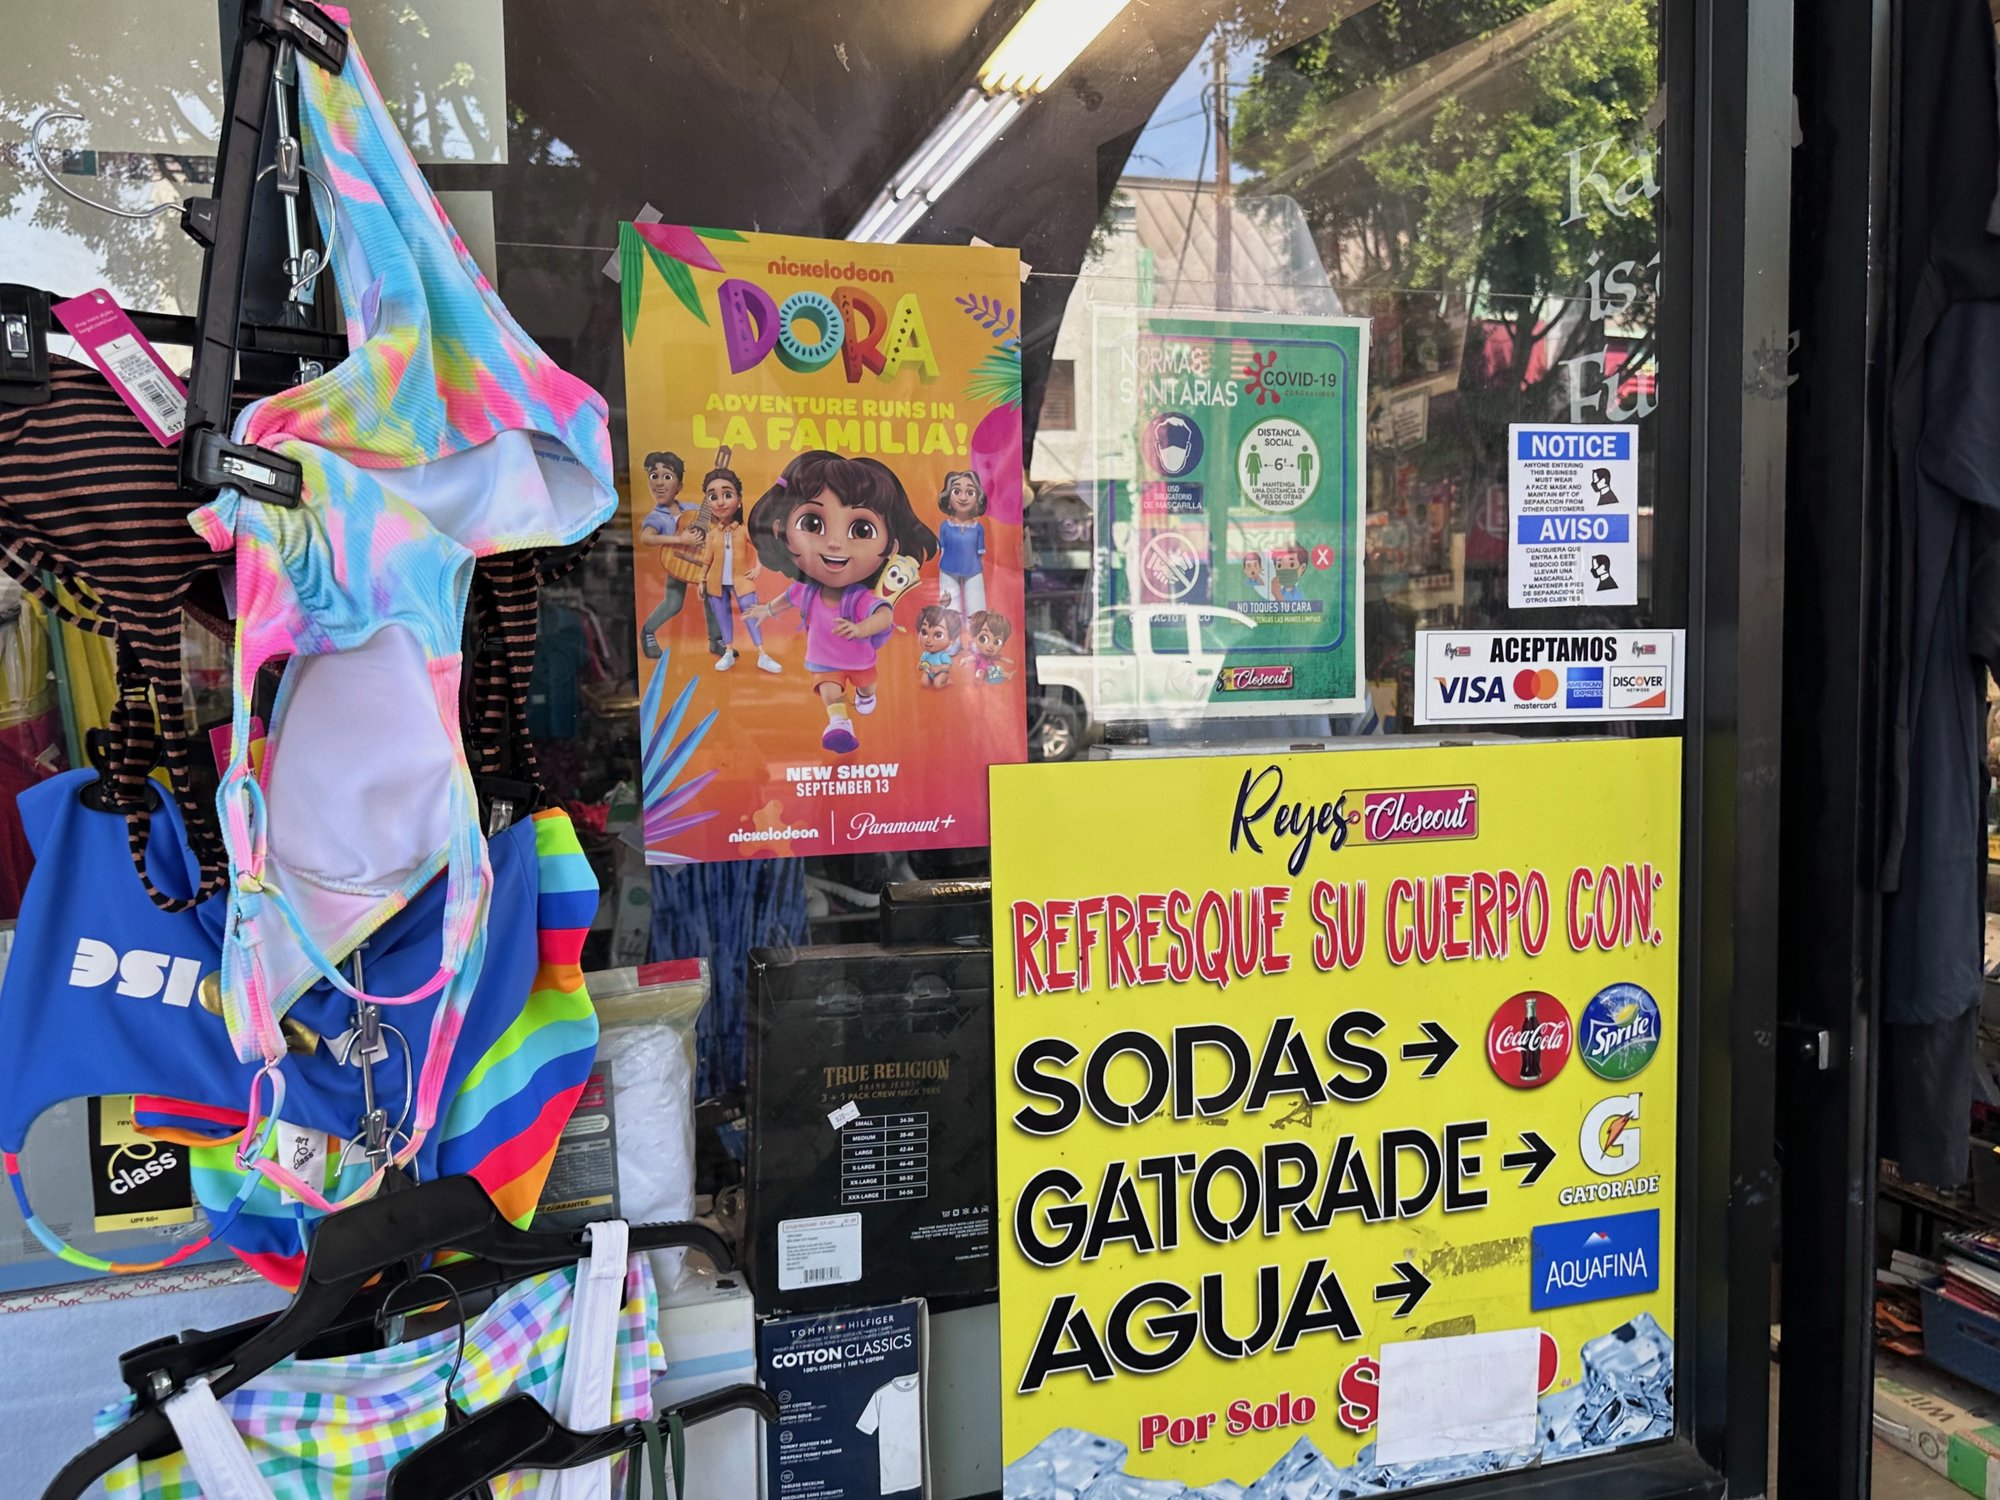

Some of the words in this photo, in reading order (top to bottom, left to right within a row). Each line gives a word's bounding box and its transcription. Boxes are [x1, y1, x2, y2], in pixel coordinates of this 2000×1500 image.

[1559, 134, 1661, 227] Ka
[767, 256, 894, 283] nickelodeon
[717, 278, 941, 385] DORA
[112, 342, 121, 350] L
[1120, 345, 1204, 374] NORMAS
[1119, 376, 1239, 407] SANITARIAS
[1263, 371, 1337, 389] COVID-19
[705, 393, 858, 417] ADVENTURE
[863, 398, 927, 420] RUNS
[931, 401, 955, 420] IN
[692, 414, 757, 451] LA
[767, 416, 969, 456] FAMILIA!
[1257, 428, 1301, 438] DISTANCIA
[1264, 438, 1294, 447] SOCIAL
[1531, 434, 1617, 458] NOTICE
[1167, 485, 1180, 493] USO
[1143, 501, 1153, 509] DE
[1155, 501, 1202, 509] MASCARILLA
[1539, 517, 1609, 541] AVISO
[1237, 602, 1248, 613] NO
[1250, 602, 1278, 613] TOQUES
[1280, 602, 1290, 612] TU
[1291, 602, 1312, 612] CARA
[1274, 615, 1284, 623] LAS
[1284, 615, 1301, 623] MANOS
[1489, 636, 1618, 663] ACEPTAMOS
[1233, 667, 1291, 689] Closeout
[1433, 676, 1507, 704] VISA
[1567, 680, 1602, 689] AMERICAN
[1613, 676, 1663, 687] DISCOVER
[1573, 689, 1603, 698] EXPRESS
[786, 764, 833, 782] NEW
[837, 763, 899, 779] SHOW
[796, 780, 873, 797] SEPTEMBER
[875, 779, 890, 794] 13
[1230, 765, 1349, 876] Reyes
[1364, 788, 1476, 840] Closeout
[728, 826, 819, 843] nickelodeon
[847, 812, 956, 842] Paramount+
[1011, 885, 1292, 996] REFRESQUE
[1313, 879, 1369, 970] SU
[1385, 868, 1549, 966] CUERPO
[1568, 863, 1664, 952] CON:
[1495, 1021, 1565, 1056] Coca-Cola
[1592, 1013, 1649, 1057] Sprite
[823, 1064, 869, 1089] TRUE
[873, 1059, 951, 1081] RELIGION
[1013, 1008, 1389, 1136] SODAS
[821, 1094, 828, 1103] 3
[841, 1093, 846, 1101] 1
[847, 1092, 870, 1101] PACK
[871, 1090, 896, 1099] CREW
[897, 1089, 920, 1098] NECK
[854, 1119, 874, 1127] SMALL
[1579, 1092, 1643, 1177] G
[295, 1136, 309, 1146] art
[852, 1134, 876, 1142] MEDIUM
[293, 1151, 314, 1171] class
[851, 1163, 876, 1171] X-LARGE
[109, 1152, 178, 1195] class
[850, 1177, 878, 1186] XX-LARGE
[848, 1191, 880, 1200] XXX-LARGE
[1014, 1120, 1488, 1268] GATORADE
[1559, 1175, 1660, 1206] GATORADE
[1545, 1247, 1648, 1294] AQUAFINA
[790, 1325, 833, 1338] TOMMY
[848, 1315, 895, 1330] HILFIGER
[1016, 1257, 1361, 1396] AGUA
[772, 1345, 842, 1369] COTTON
[844, 1333, 912, 1358] CLASSICS
[819, 1363, 842, 1371] COTTON
[865, 1355, 885, 1364] COTON
[1140, 1413, 1216, 1451] Por
[1226, 1394, 1316, 1433] Solo
